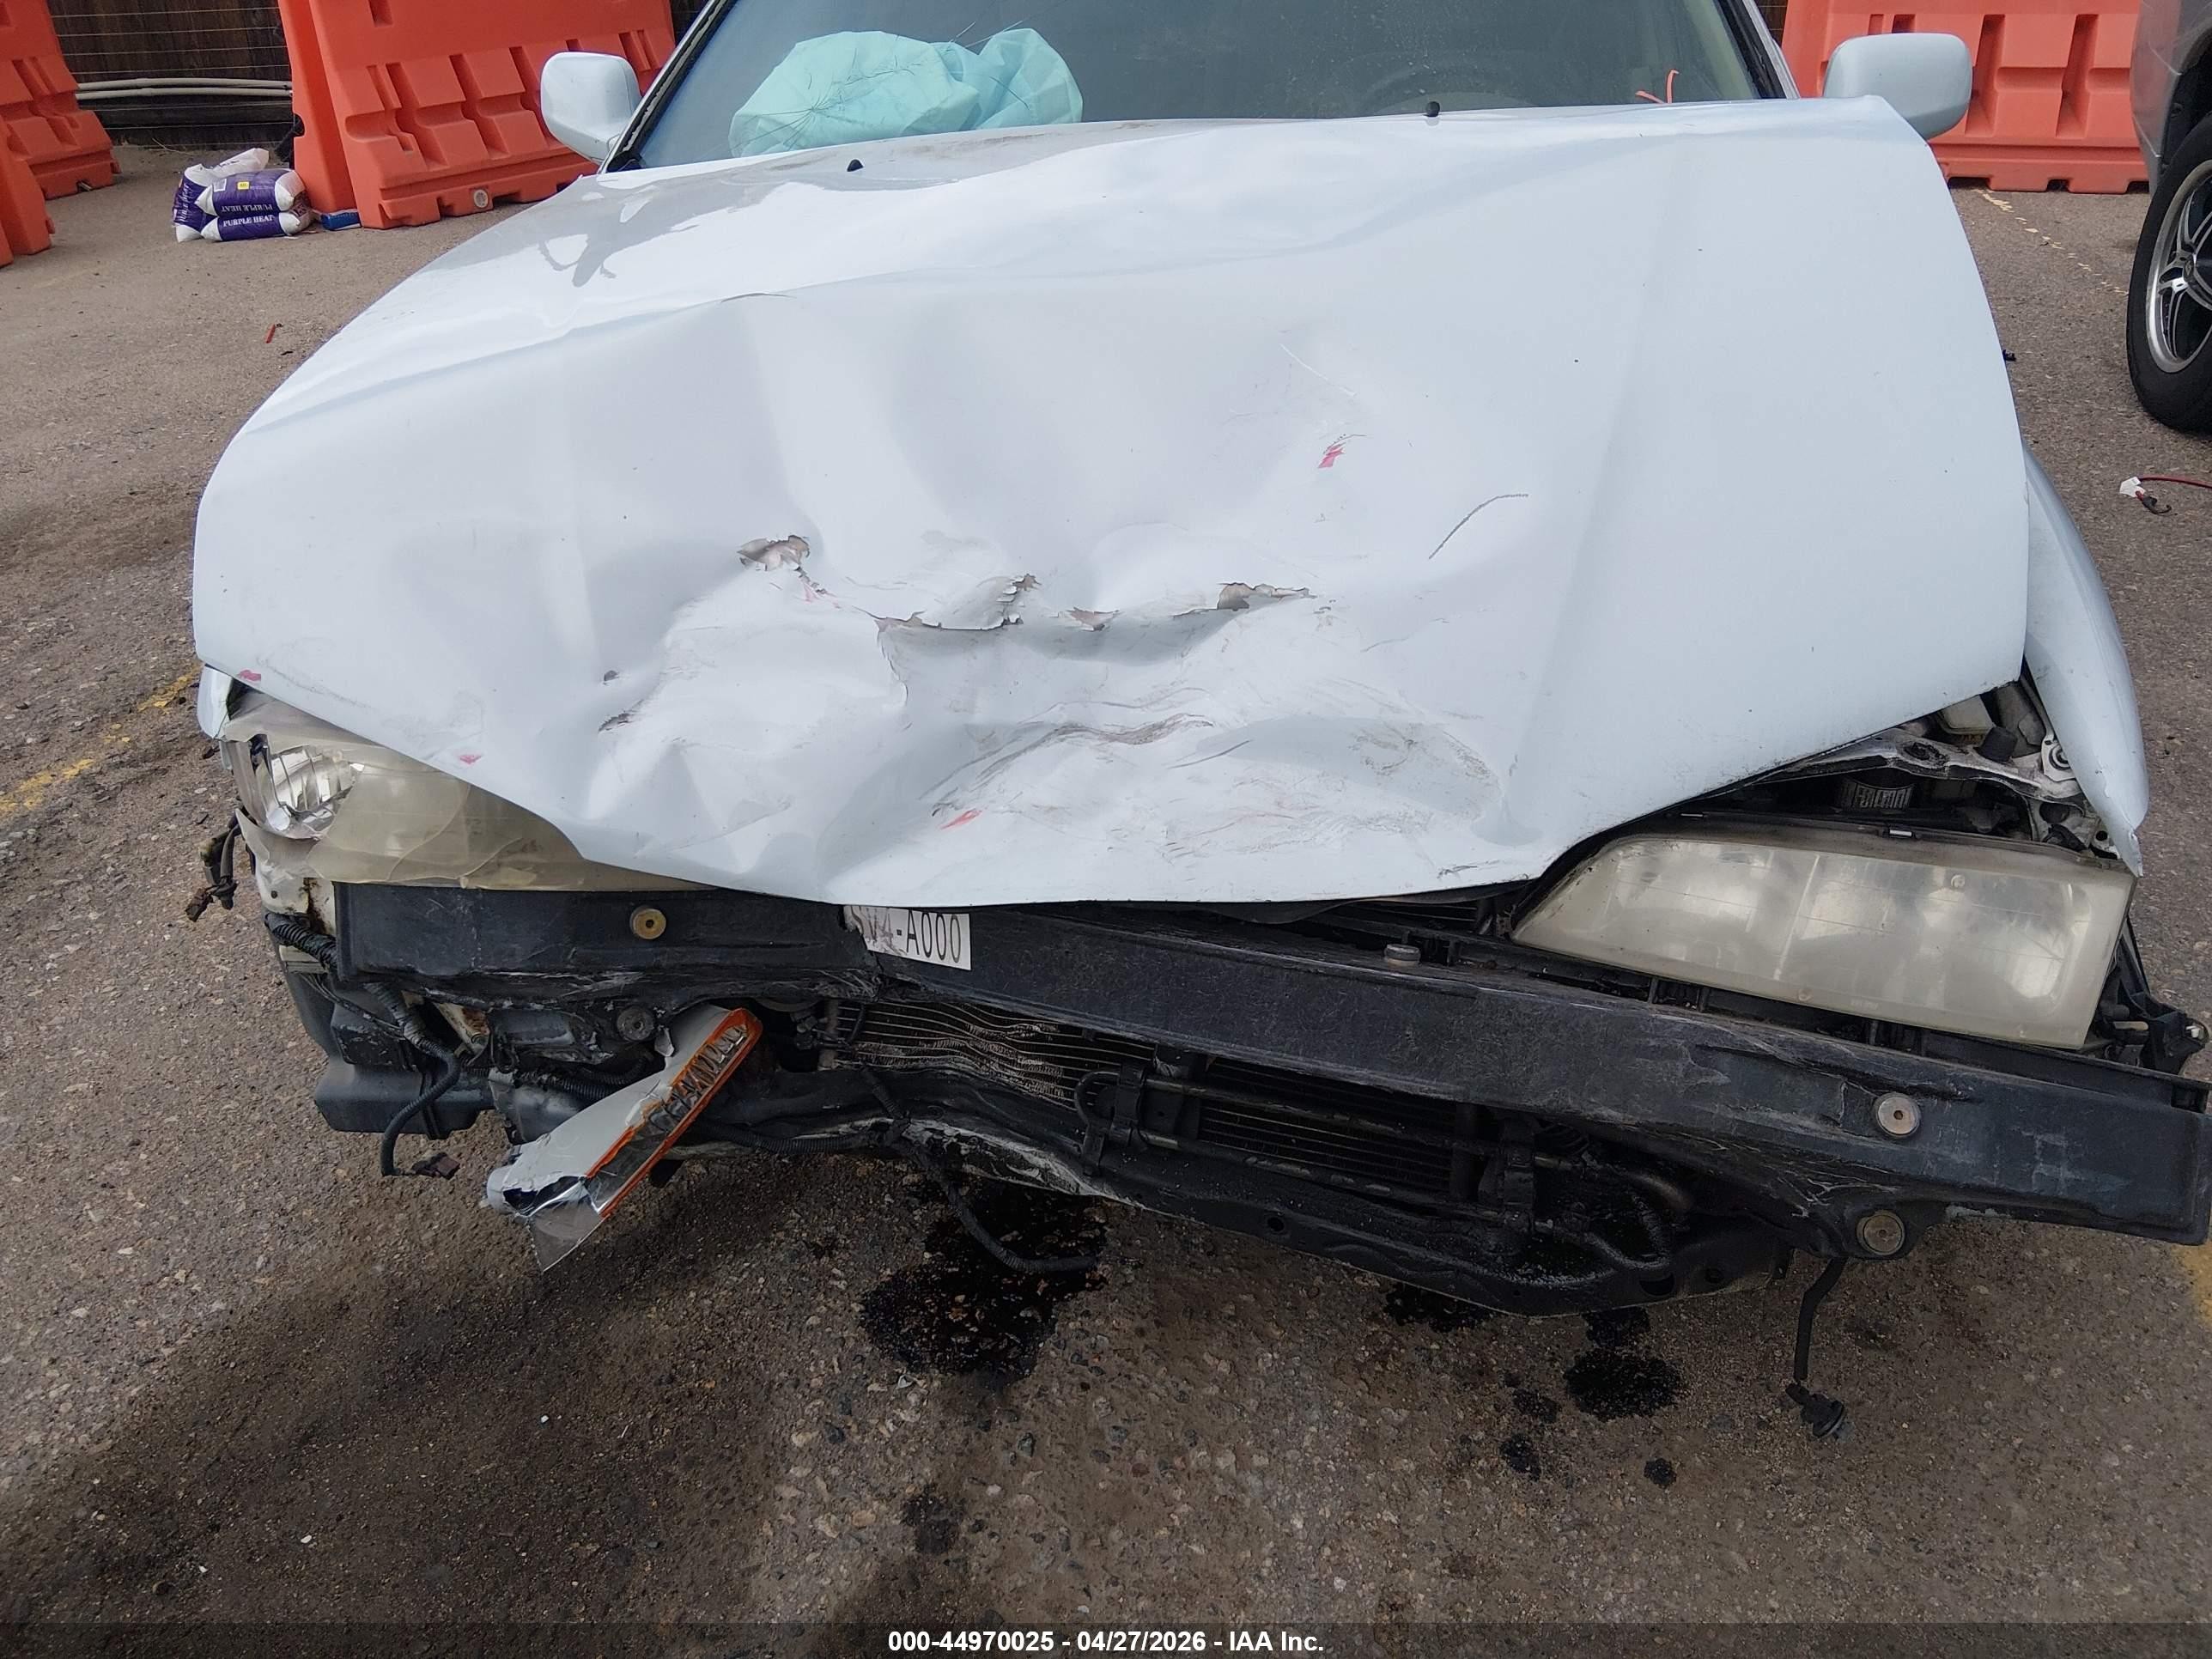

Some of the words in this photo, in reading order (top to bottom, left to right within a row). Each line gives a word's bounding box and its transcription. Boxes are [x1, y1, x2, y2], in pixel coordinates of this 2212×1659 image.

[243, 204, 273, 212] PURPLE
[223, 217, 252, 228] PURPLE
[253, 215, 275, 223] HEAT
